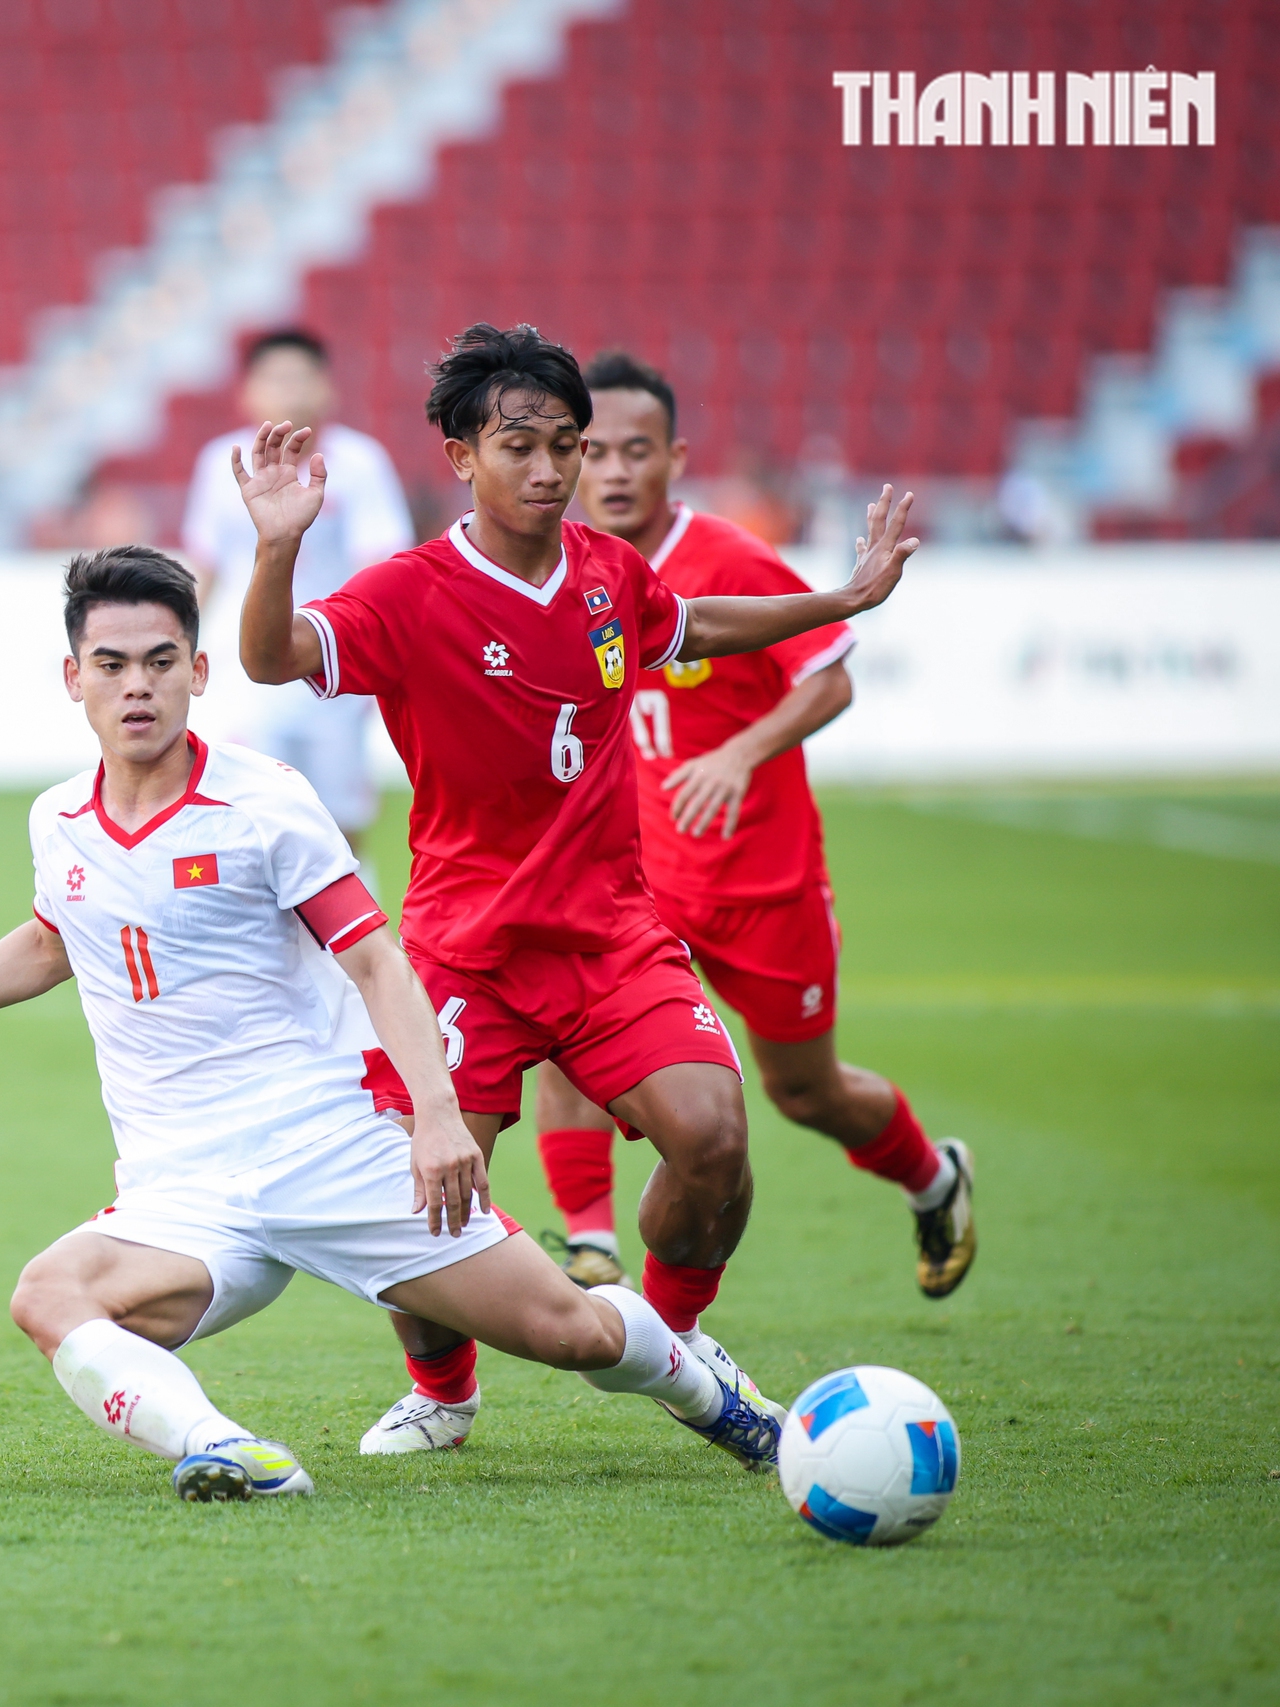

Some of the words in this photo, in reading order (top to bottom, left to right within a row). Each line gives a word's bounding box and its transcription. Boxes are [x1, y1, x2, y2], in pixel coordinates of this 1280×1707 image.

[601, 626, 615, 641] LAOS
[550, 702, 584, 783] 6
[120, 923, 161, 1004] 11
[436, 995, 468, 1073] 6
